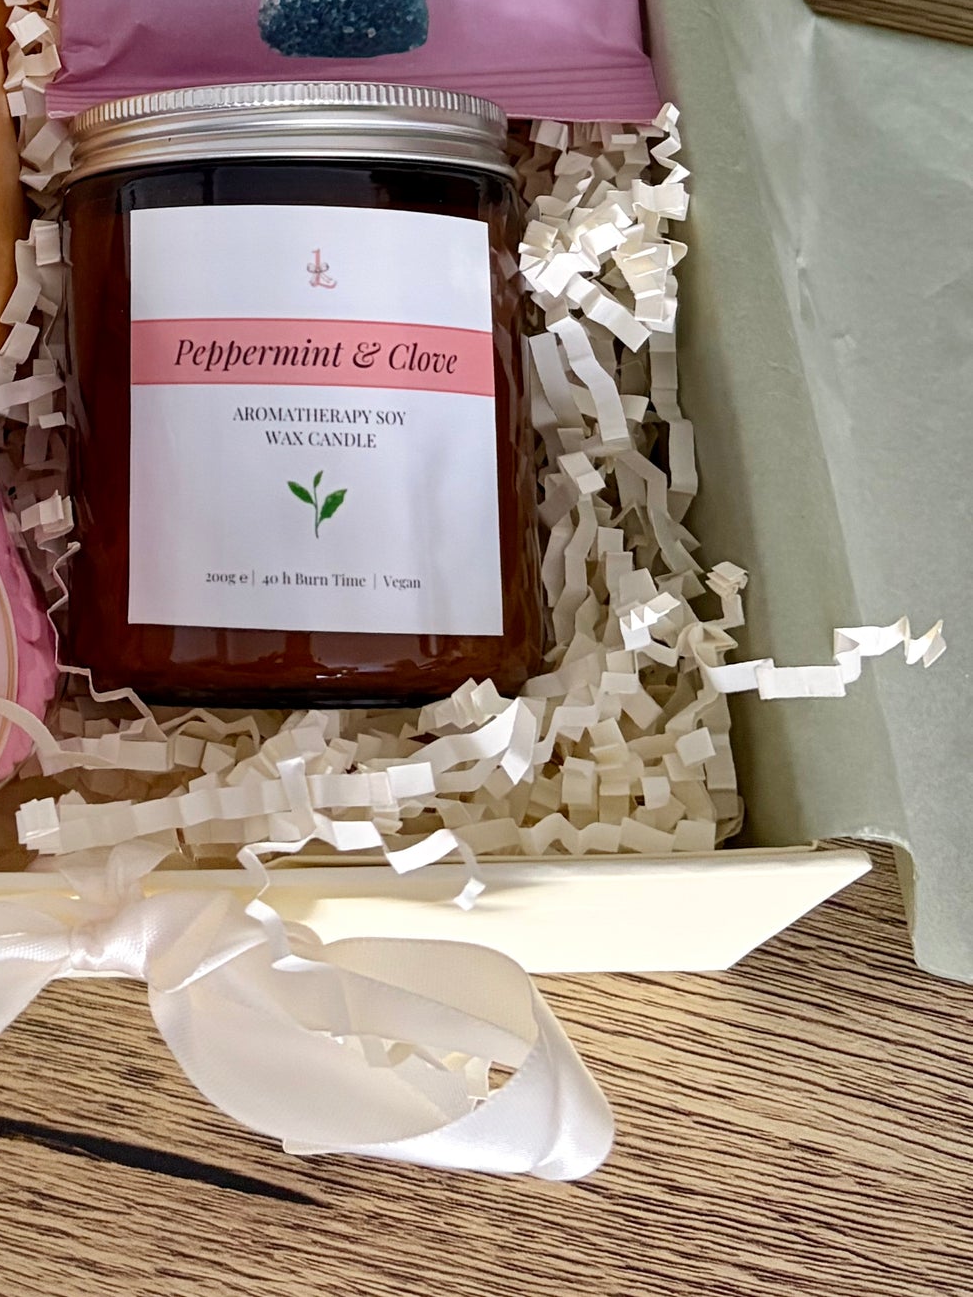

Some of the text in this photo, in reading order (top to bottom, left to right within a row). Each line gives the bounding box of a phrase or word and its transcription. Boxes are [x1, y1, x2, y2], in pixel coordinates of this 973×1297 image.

[174, 339, 458, 374] Peppermint & Clove
[233, 406, 406, 426] AROMATHERAPY SOY
[265, 430, 377, 448] WAX CANDLE
[205, 572, 236, 585] 200g
[262, 575, 278, 586] 40
[282, 571, 291, 585] h
[295, 572, 328, 586] Burn
[332, 573, 366, 587] Time
[383, 575, 421, 590] Vegan
